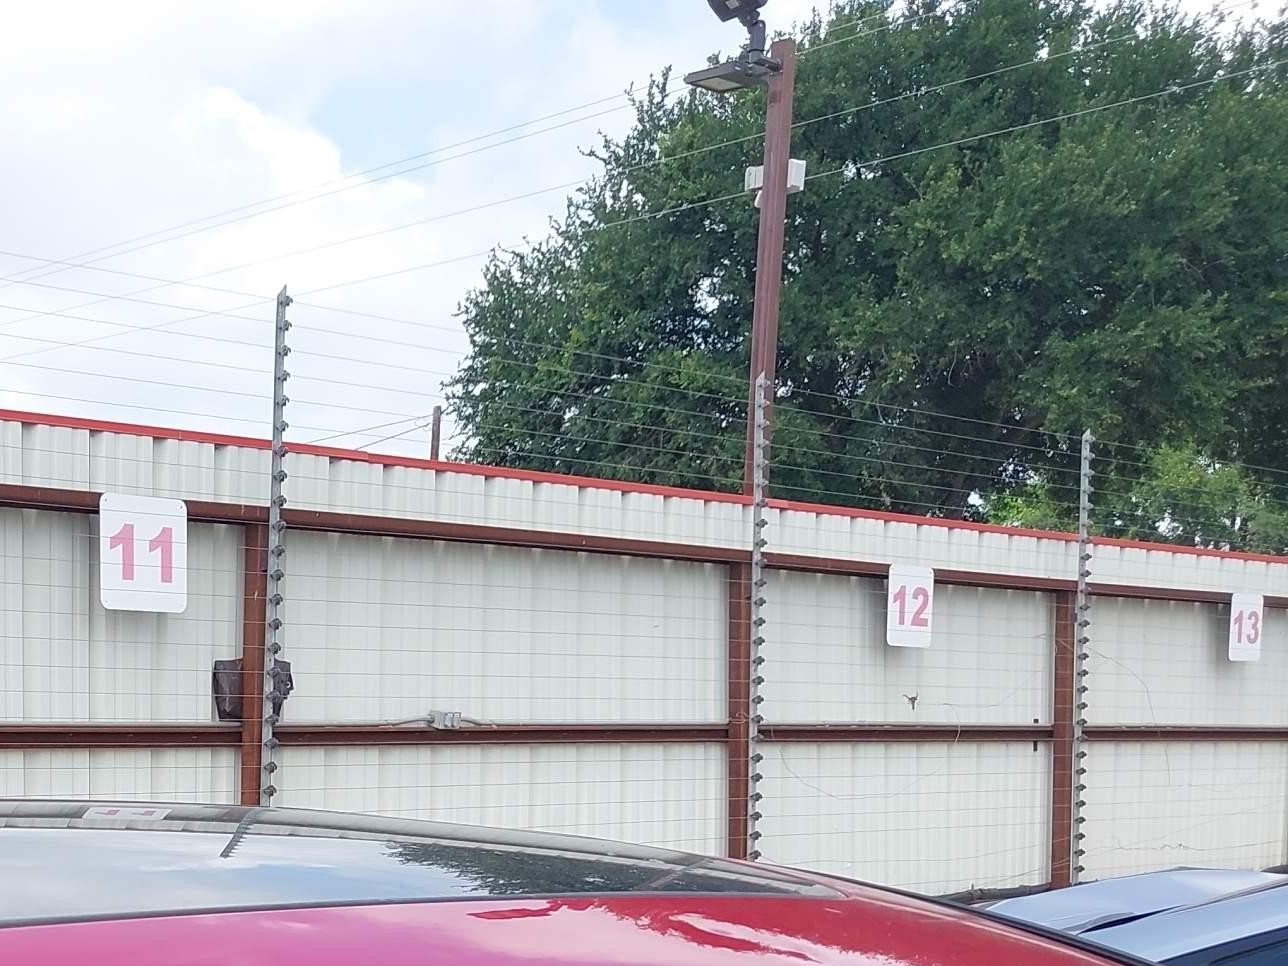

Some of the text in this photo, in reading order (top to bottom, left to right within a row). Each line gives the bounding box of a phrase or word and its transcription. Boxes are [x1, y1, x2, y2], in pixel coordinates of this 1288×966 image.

[109, 523, 173, 583] 11
[892, 585, 929, 627] 12
[1233, 610, 1260, 645] 13
